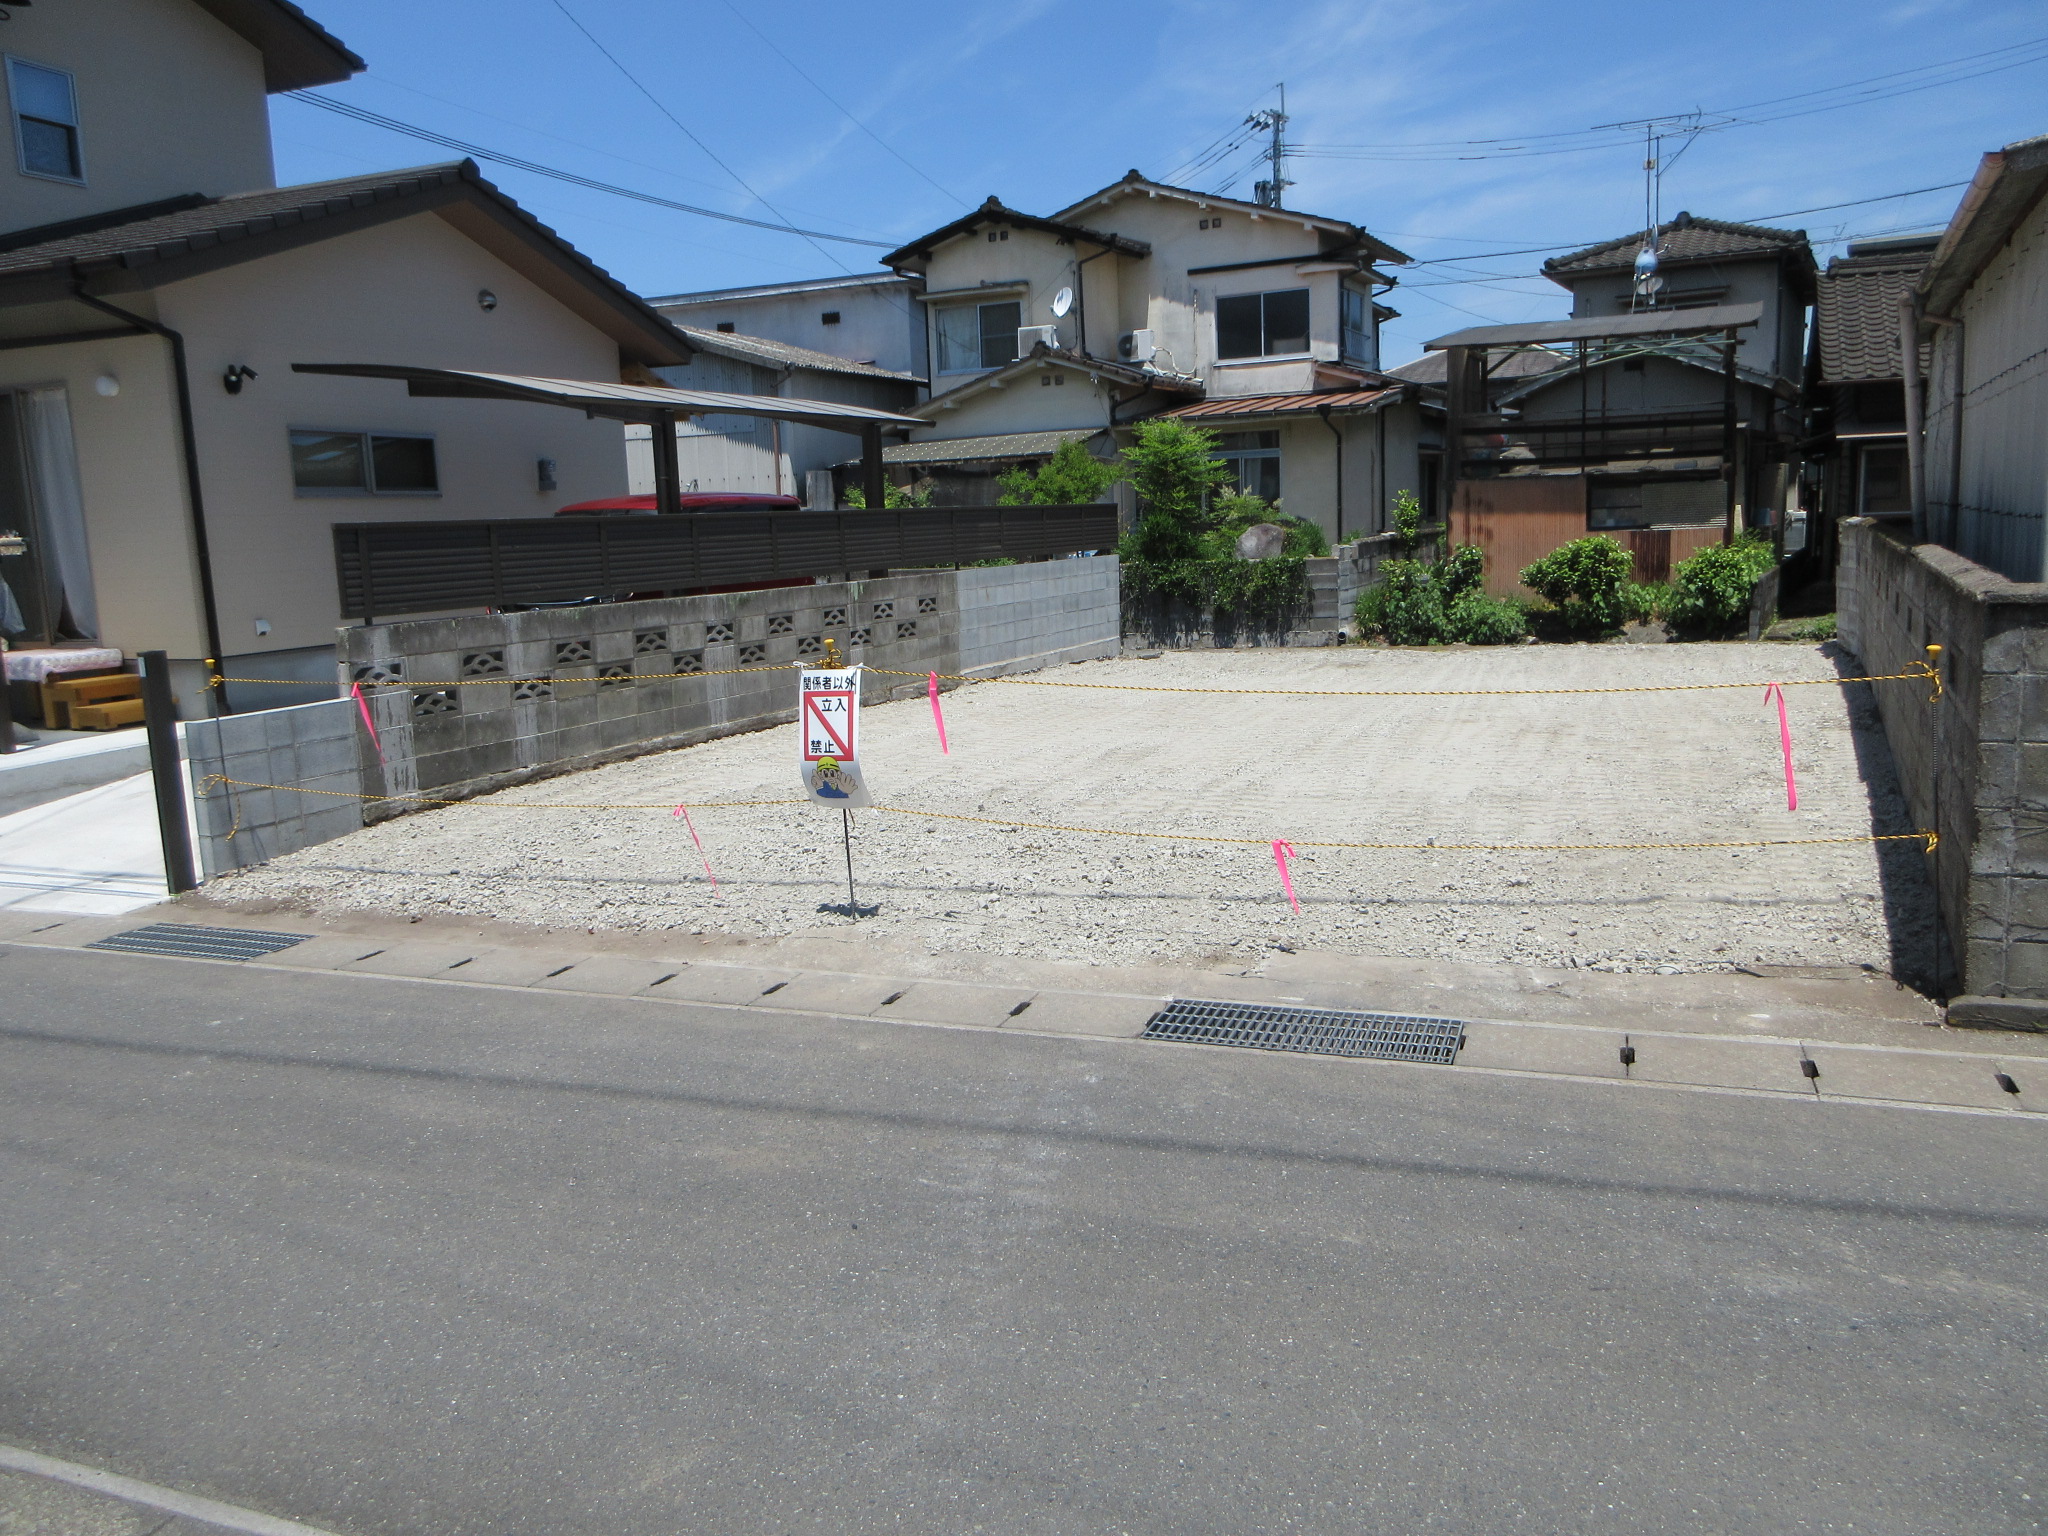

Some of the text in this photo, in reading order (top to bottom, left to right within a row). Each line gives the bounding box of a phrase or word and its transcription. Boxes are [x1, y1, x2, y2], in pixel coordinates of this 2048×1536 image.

[803, 676, 856, 690] 関係者以外
[821, 698, 847, 712] 立入
[810, 739, 836, 754] 禁止
